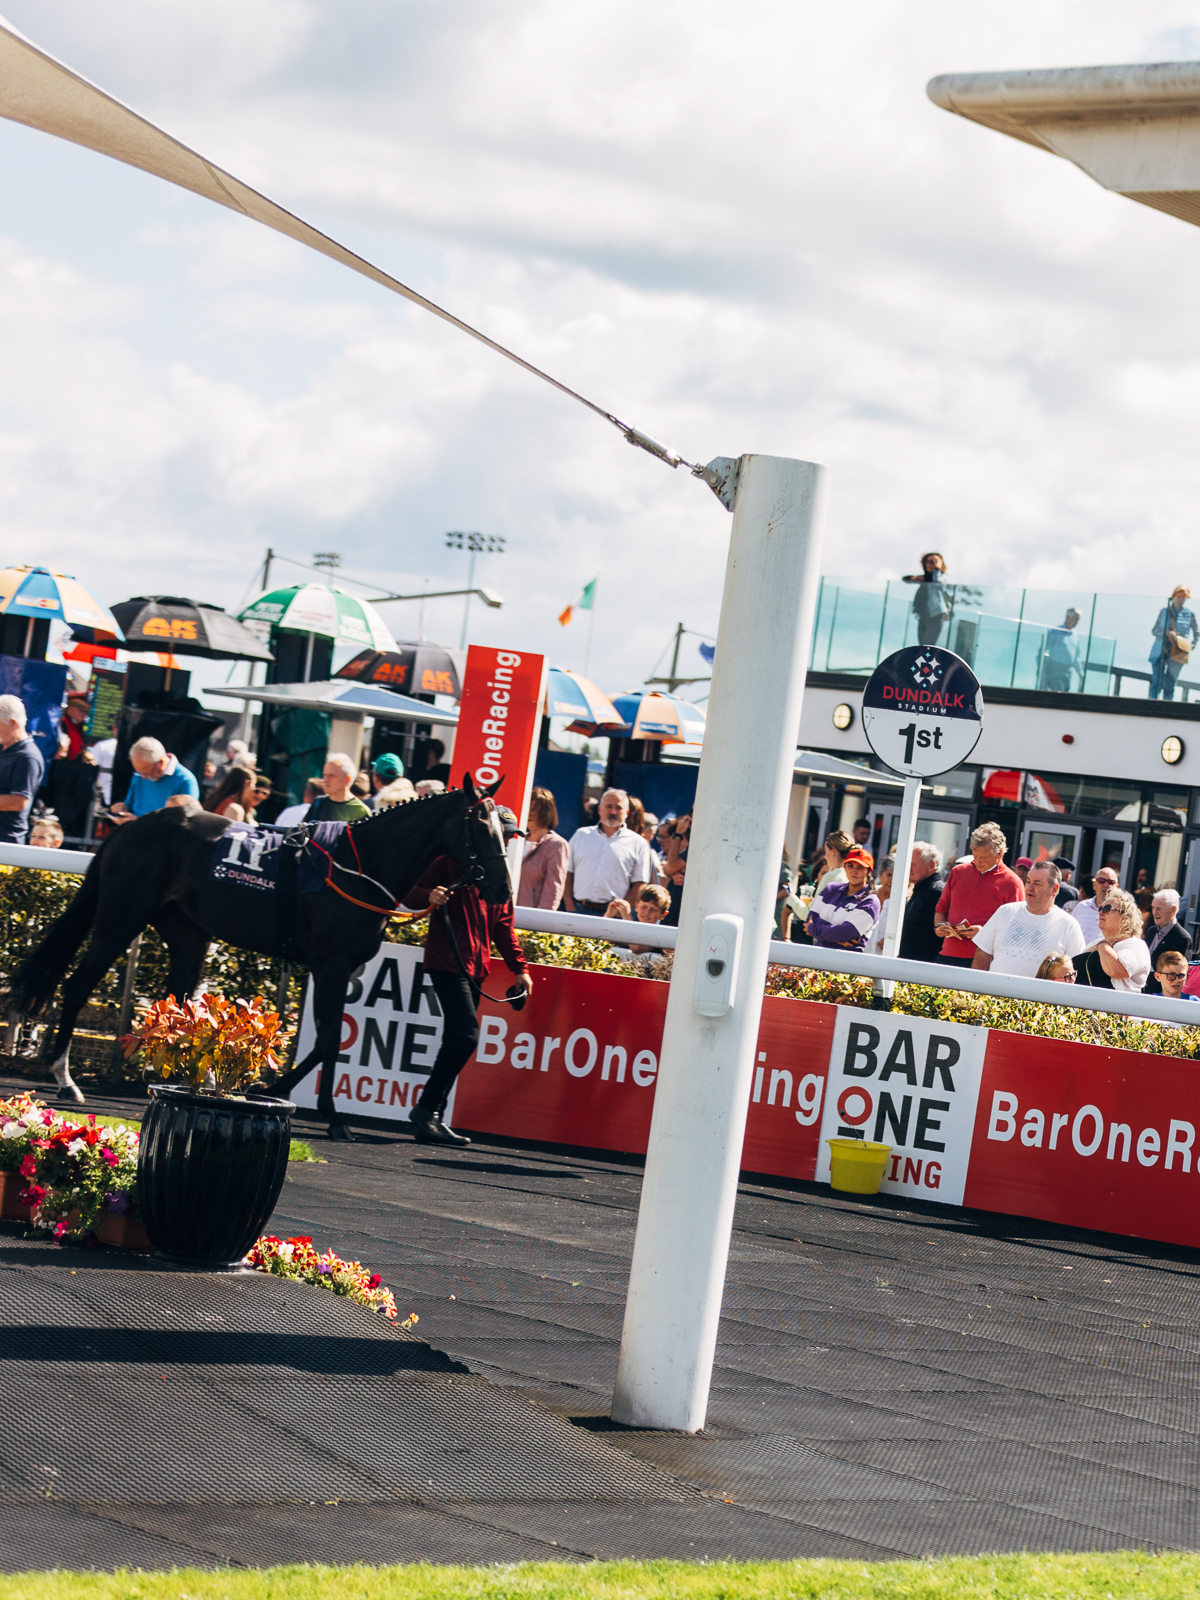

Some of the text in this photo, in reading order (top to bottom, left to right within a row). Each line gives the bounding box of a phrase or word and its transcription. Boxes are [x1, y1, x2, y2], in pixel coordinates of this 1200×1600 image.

[142, 627, 198, 640] BETS
[143, 617, 198, 632] AK
[421, 669, 452, 684] AK
[882, 685, 965, 709] DUNDALK
[898, 702, 947, 714] STADIUM
[475, 651, 522, 790] OneRacing
[898, 722, 944, 765] 1st
[227, 869, 276, 889] DUNDALK
[842, 1021, 961, 1093] BAR
[314, 1068, 426, 1109] ACIN
[836, 1085, 951, 1154] ONE
